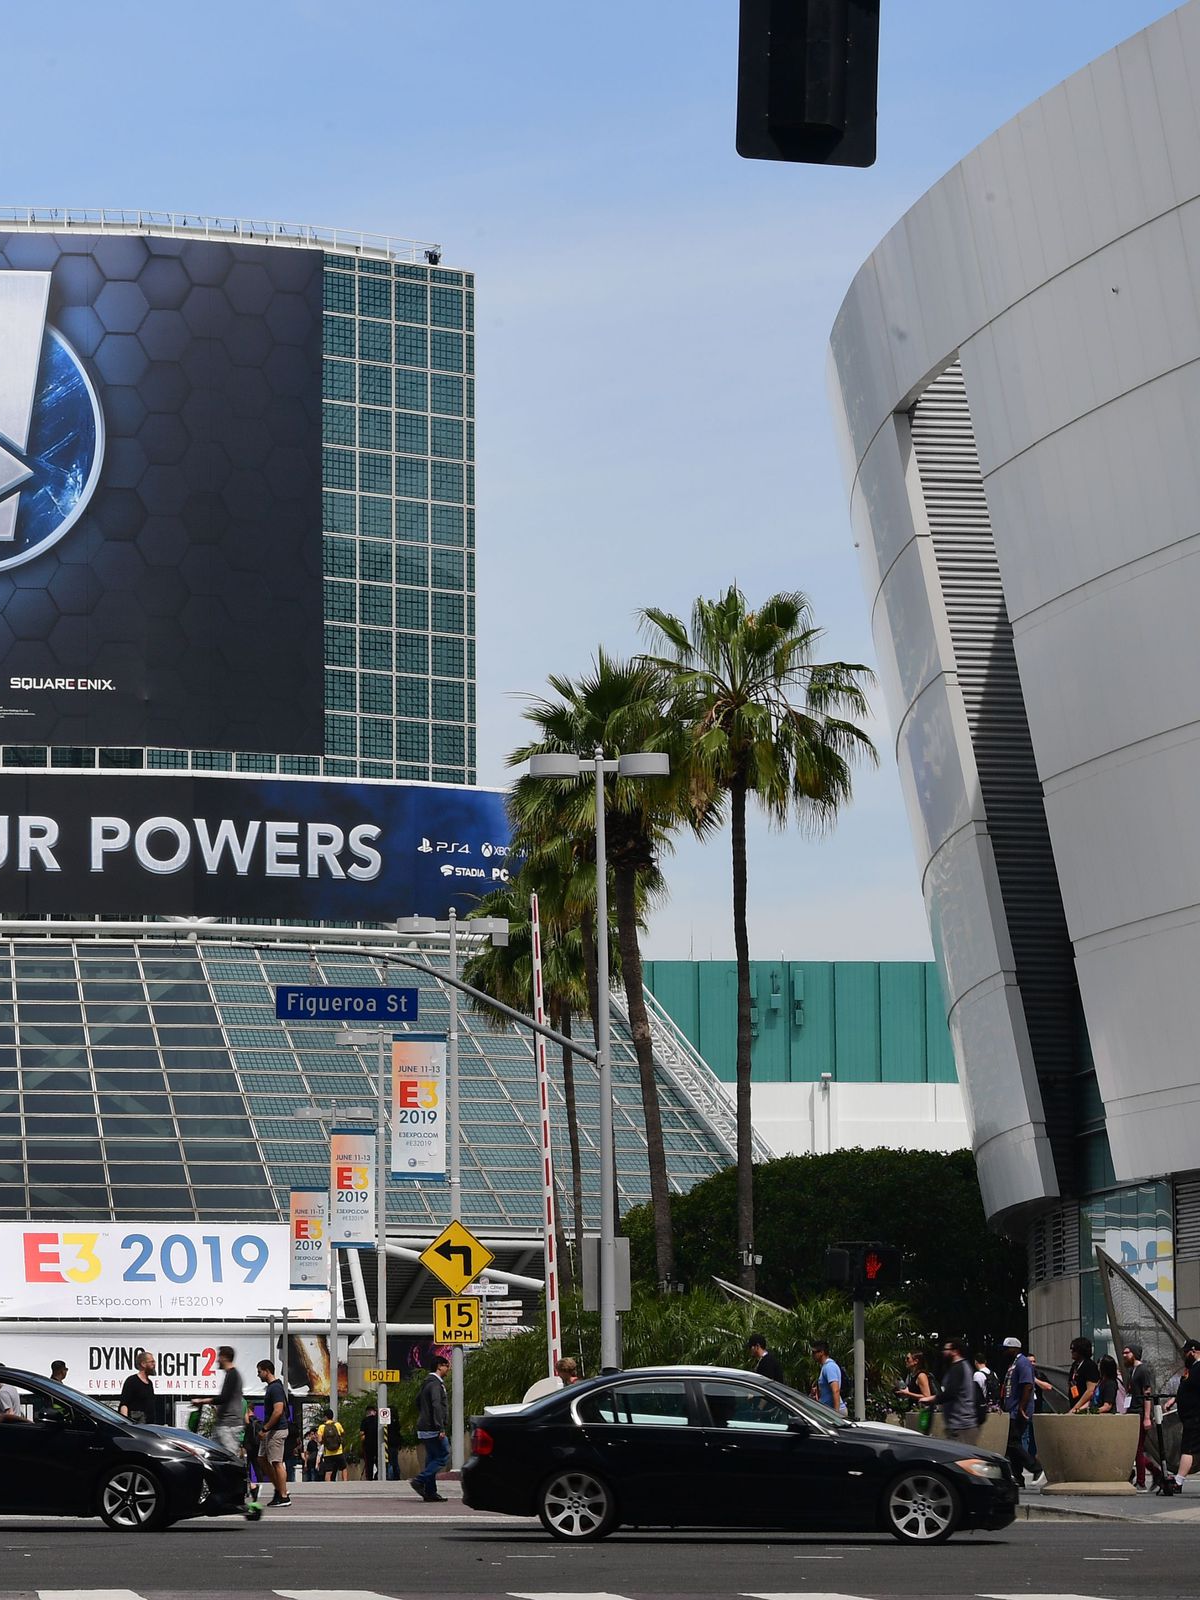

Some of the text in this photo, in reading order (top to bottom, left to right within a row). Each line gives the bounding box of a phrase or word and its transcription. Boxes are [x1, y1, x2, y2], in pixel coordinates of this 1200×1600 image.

[10, 677, 74, 690] SQUARE
[90, 816, 382, 882] POWERS
[436, 841, 470, 854] PS4
[455, 866, 486, 878] STADIA
[491, 867, 510, 882] PC
[287, 993, 408, 1017] Figueroa St
[398, 1065, 441, 1073] JUNE 11-13
[399, 1080, 439, 1108] E3
[399, 1110, 438, 1125] 2019
[336, 1167, 369, 1190] E3
[336, 1191, 369, 1203] 2019
[295, 1219, 323, 1240] E3
[295, 1240, 322, 1251] 2019
[22, 1232, 102, 1284] E3
[120, 1233, 269, 1284] 2019
[76, 1295, 224, 1308] E3Expo.com #E32019
[444, 1303, 473, 1328] 15
[442, 1330, 473, 1340] MPH
[158, 1353, 200, 1376] IGHT
[201, 1347, 217, 1377] 2
[368, 1370, 396, 1381] 150 FT
[166, 1379, 217, 1389] MATTERS
